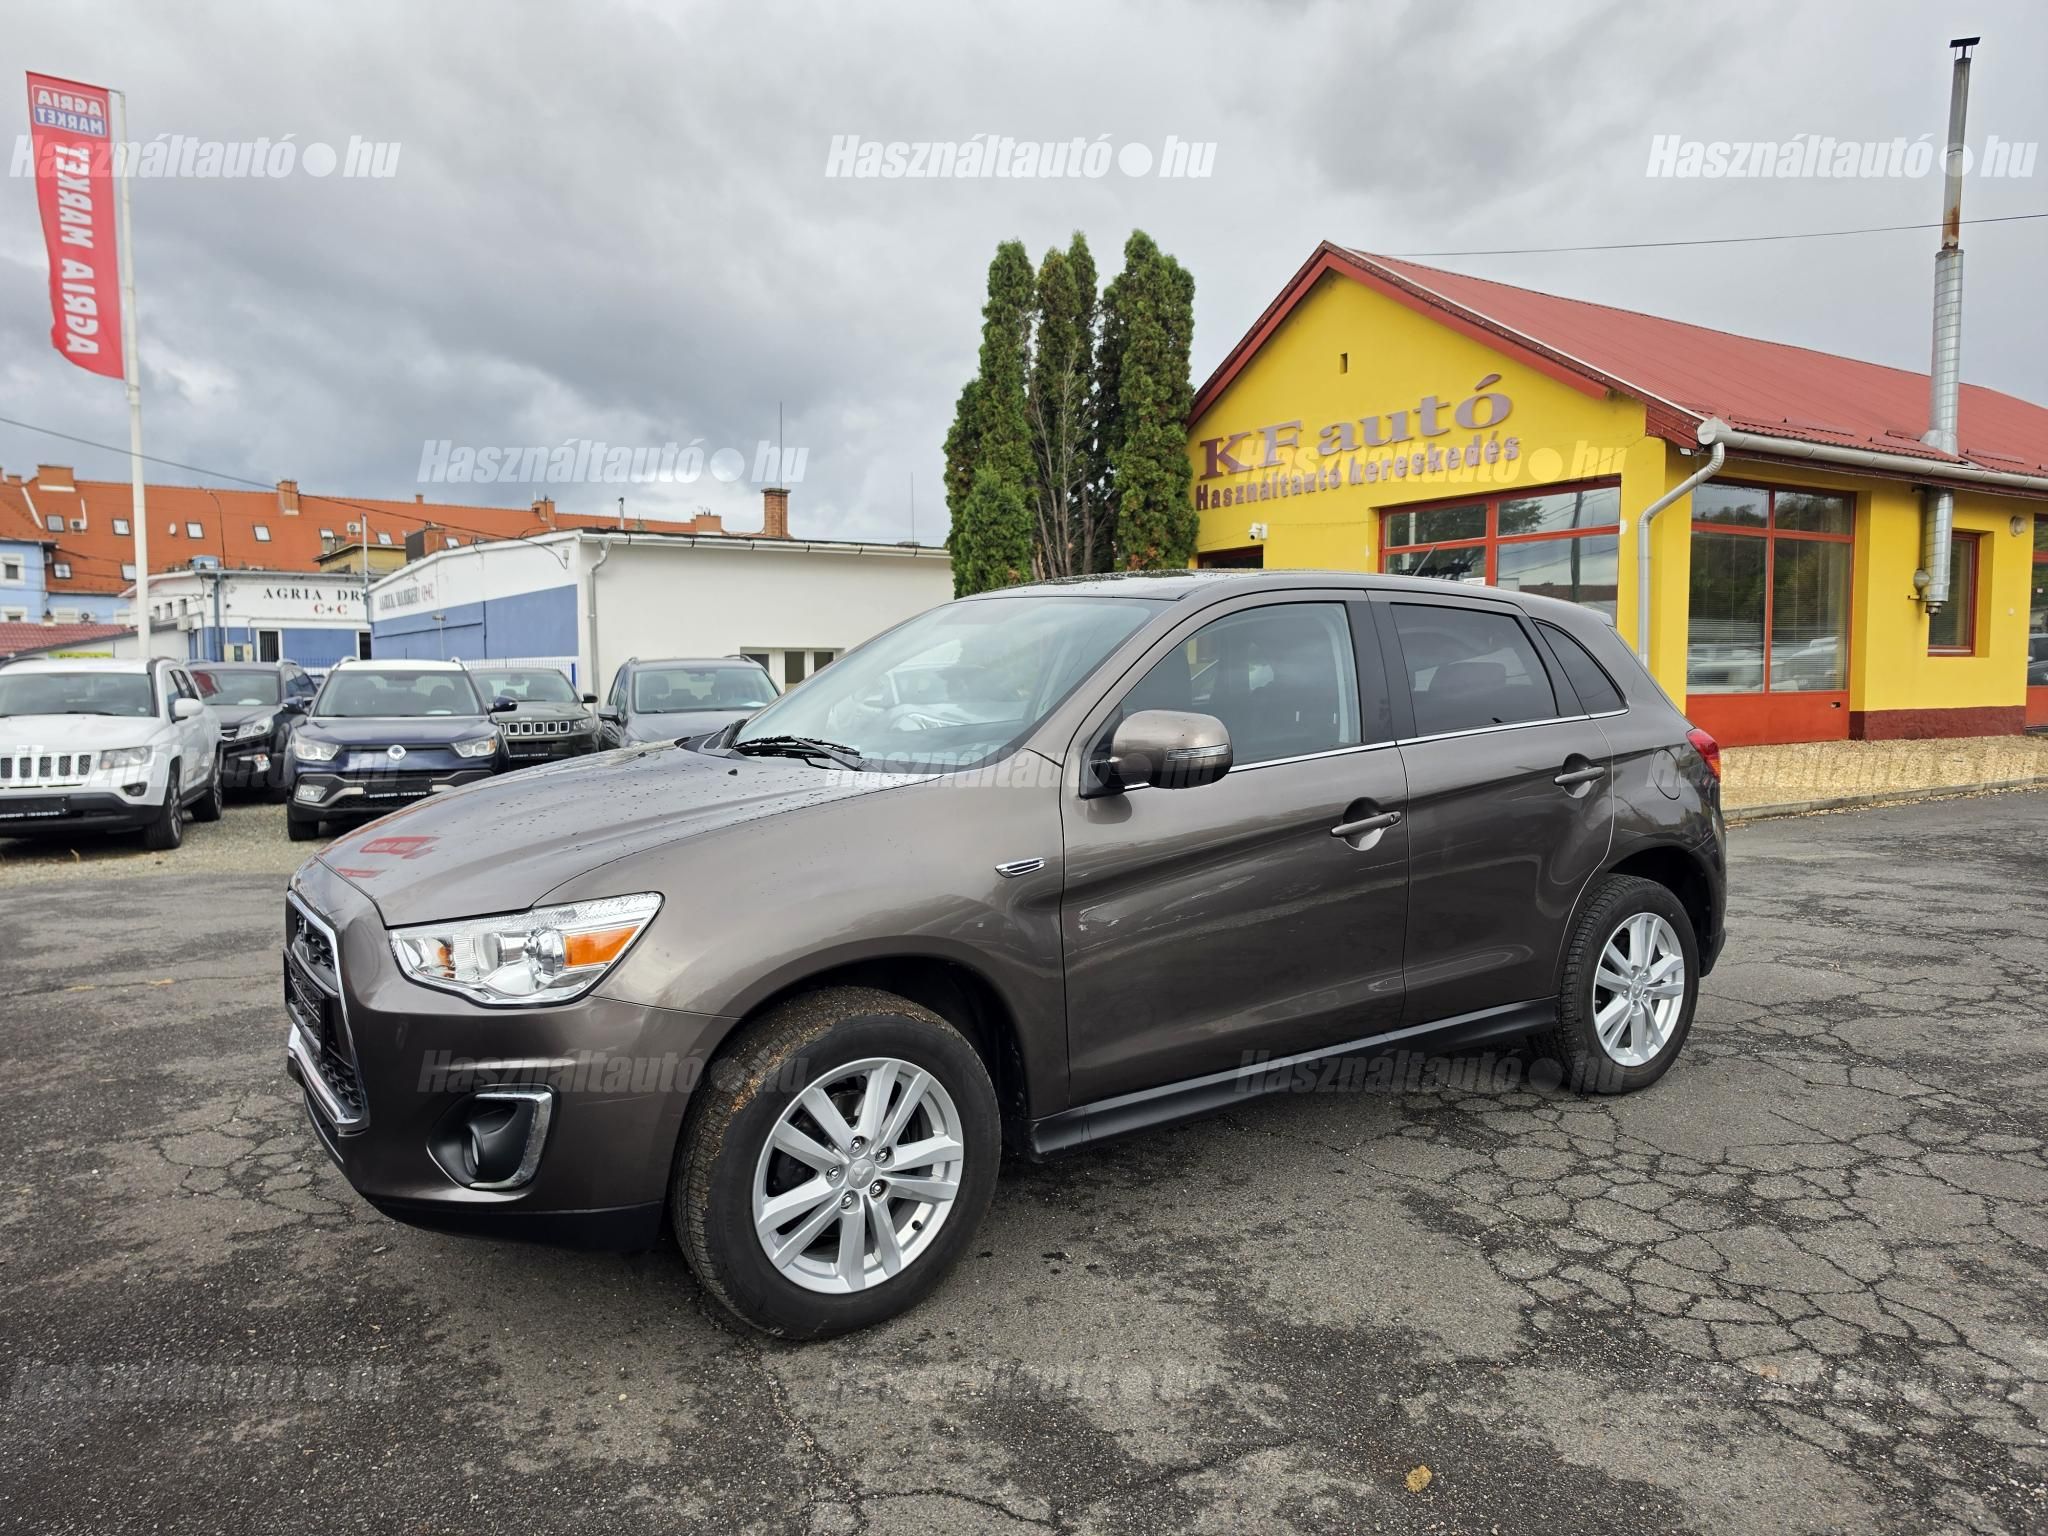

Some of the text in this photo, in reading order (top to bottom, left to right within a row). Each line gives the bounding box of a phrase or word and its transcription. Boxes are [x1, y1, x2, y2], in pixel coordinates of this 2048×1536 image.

[1199, 373, 1513, 480] KF autó
[1196, 430, 1521, 511] Használtautó kereskedés
[264, 587, 322, 601] AGRIA
